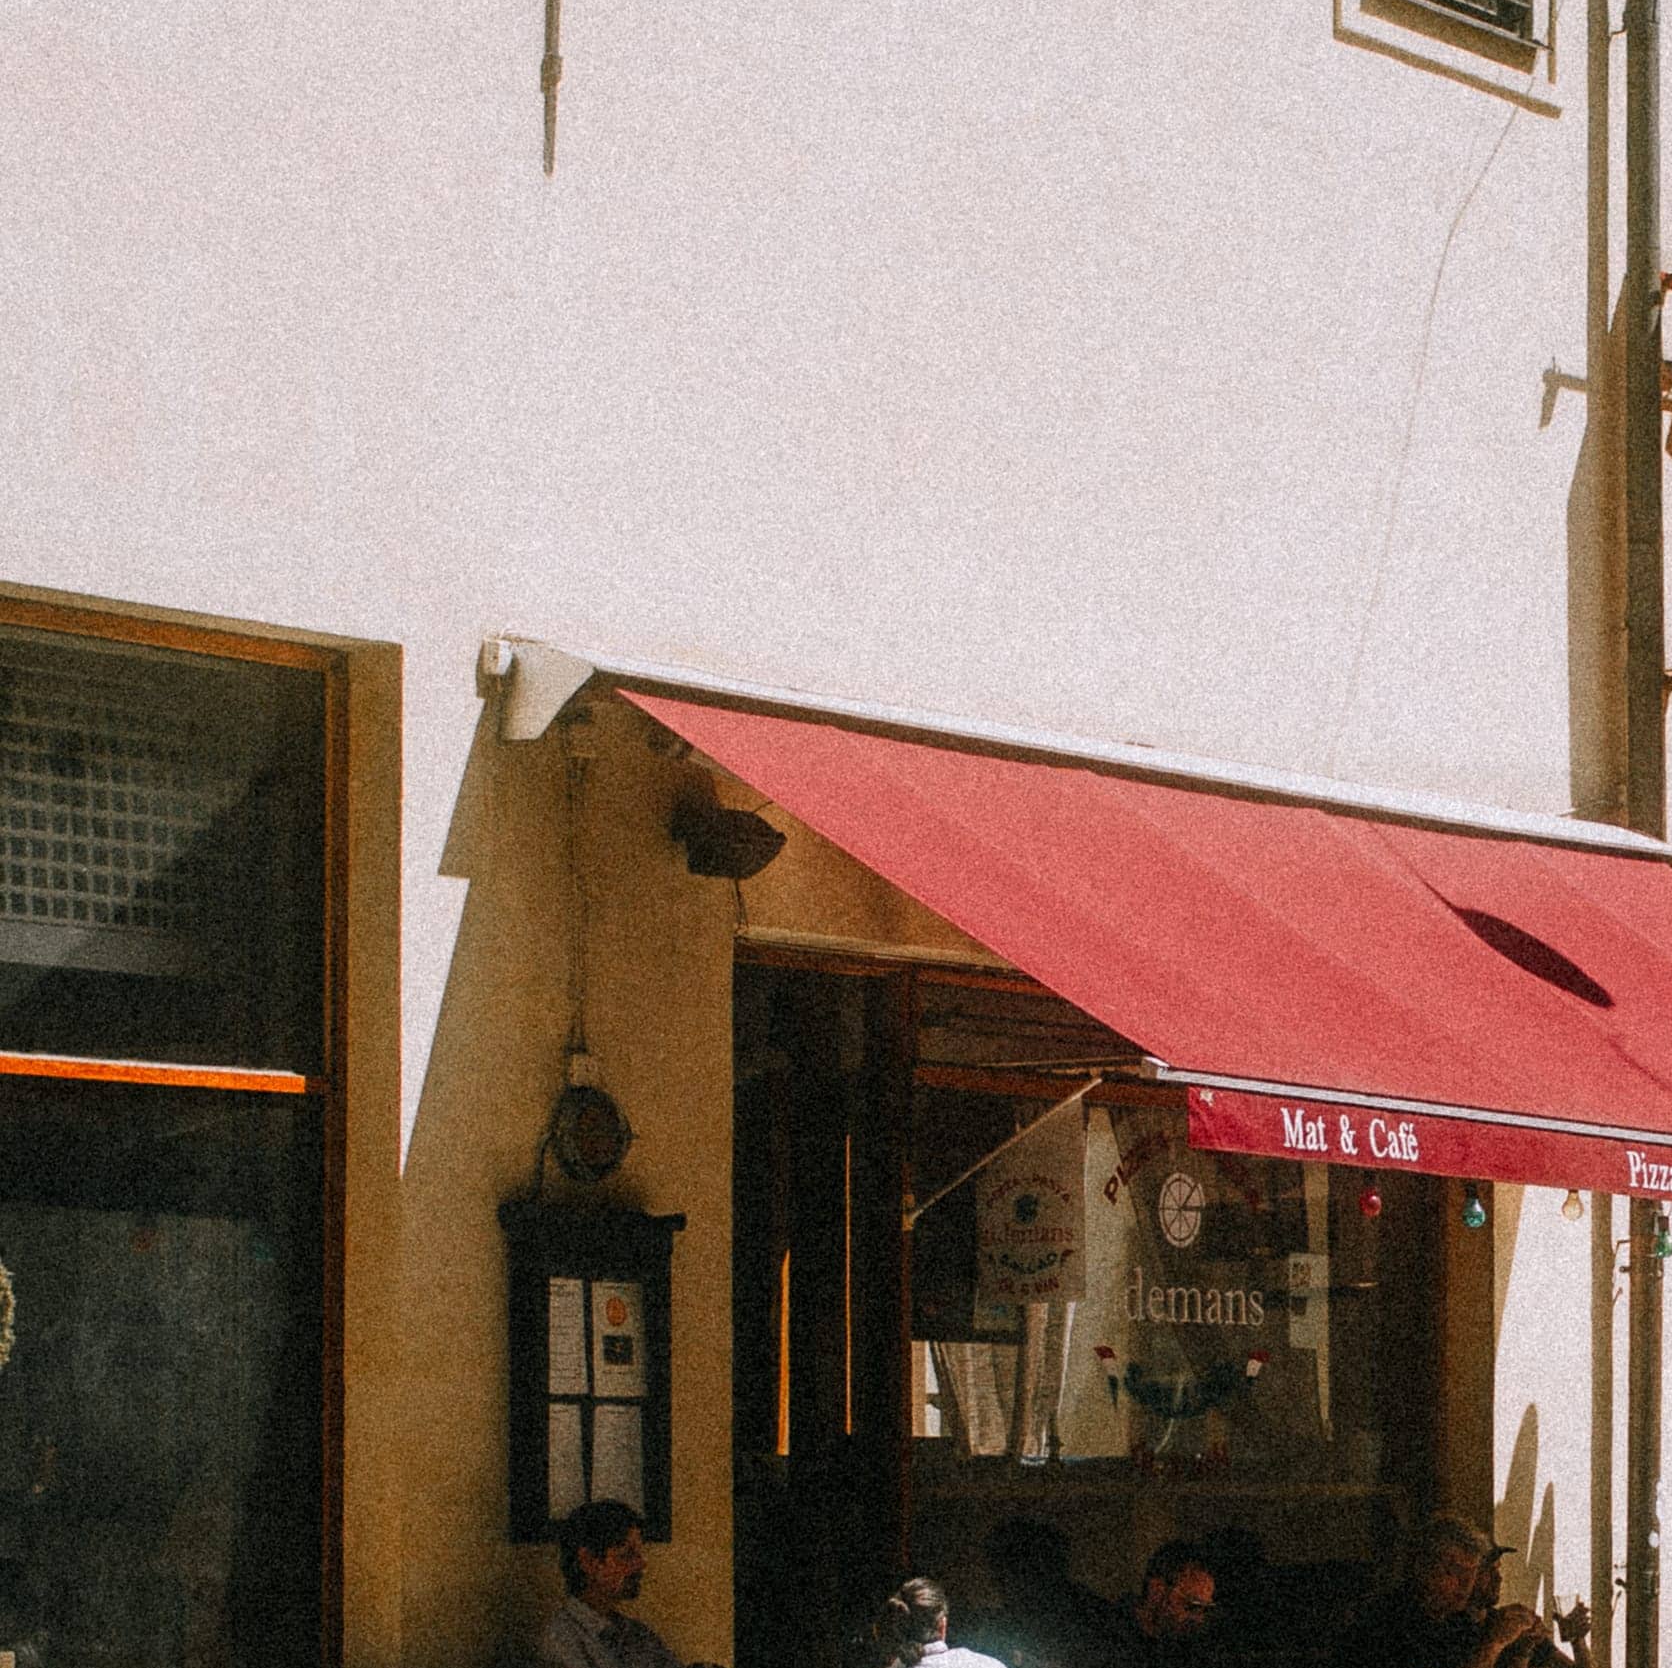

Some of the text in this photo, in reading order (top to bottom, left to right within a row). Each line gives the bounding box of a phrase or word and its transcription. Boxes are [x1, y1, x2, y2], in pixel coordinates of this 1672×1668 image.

[1280, 1107, 1420, 1162] Mat & Café
[1121, 1267, 1265, 1327] demans
